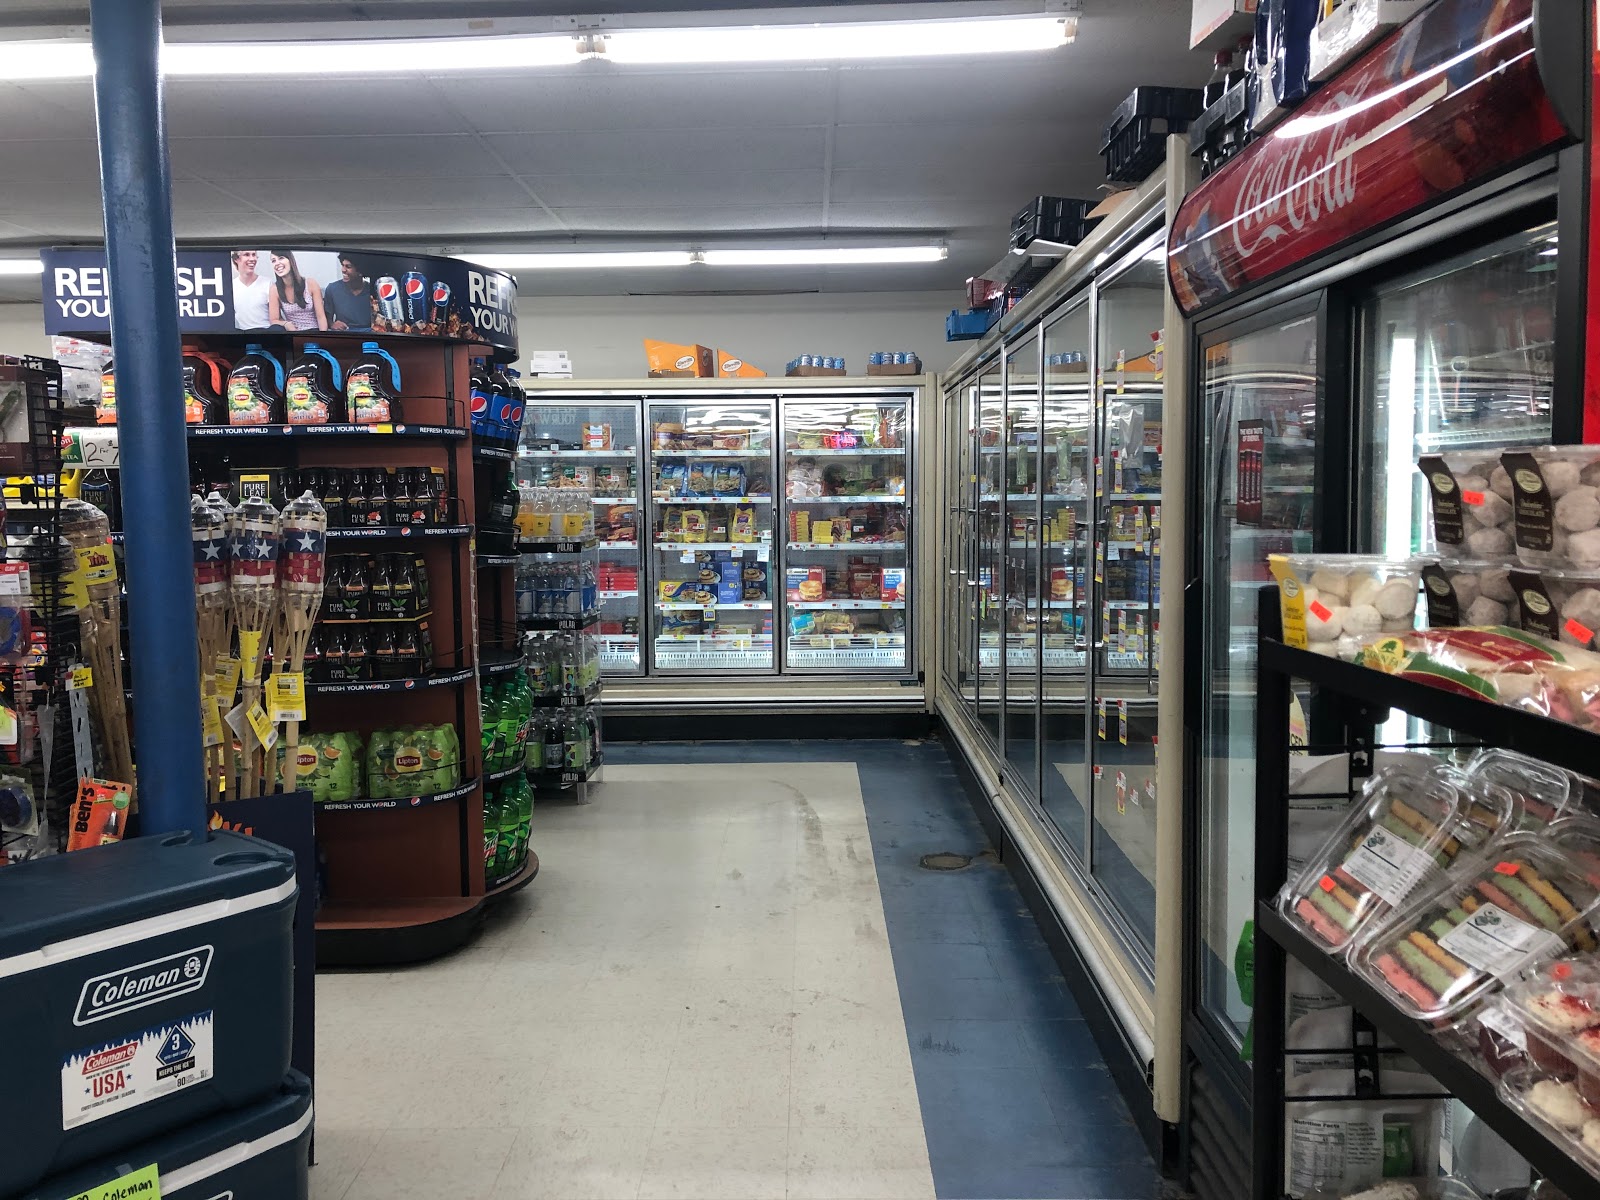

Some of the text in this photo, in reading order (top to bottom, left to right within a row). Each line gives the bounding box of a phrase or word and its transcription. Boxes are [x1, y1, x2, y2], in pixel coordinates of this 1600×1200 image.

[56, 299, 226, 318] YOU RLD
[470, 306, 509, 335] YOUR
[85, 442, 104, 462] 2
[557, 543, 574, 552] POLAR
[559, 620, 575, 629] POLAR
[428, 677, 450, 685] REFRESH
[561, 696, 577, 706] POLAR
[561, 772, 579, 782] POLAR
[433, 791, 456, 801] REFRESH
[92, 967, 180, 1007] Coleman
[171, 1033, 180, 1051] 3
[86, 1050, 126, 1070] Coleman
[93, 1070, 125, 1098] USA
[177, 1076, 186, 1087] 80
